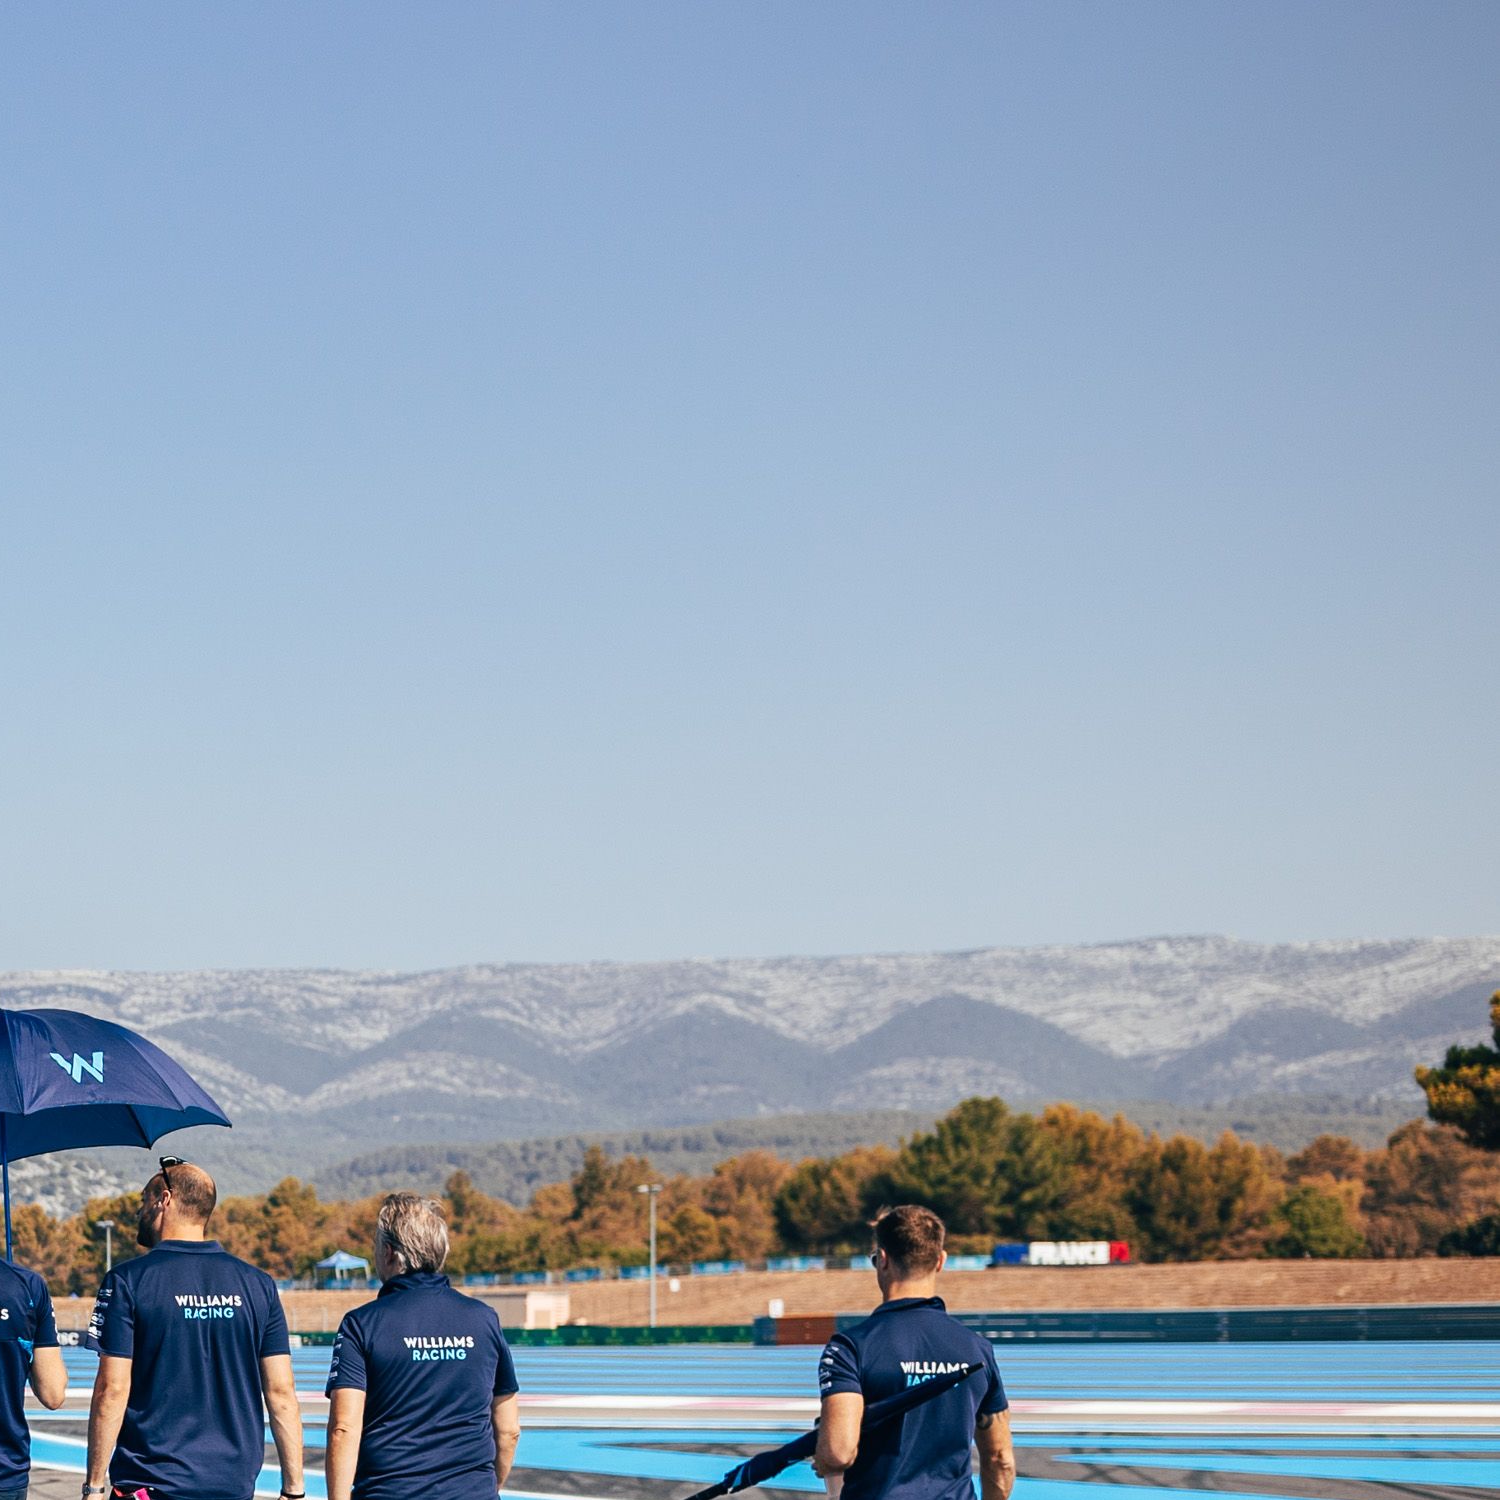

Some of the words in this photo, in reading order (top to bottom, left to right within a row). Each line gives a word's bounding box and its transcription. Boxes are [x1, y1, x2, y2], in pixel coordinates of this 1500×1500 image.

[175, 1295, 242, 1307] WILLIAMS
[184, 1307, 235, 1320] RACING
[403, 1335, 475, 1349] WILLIAMS
[412, 1348, 467, 1361] RACING
